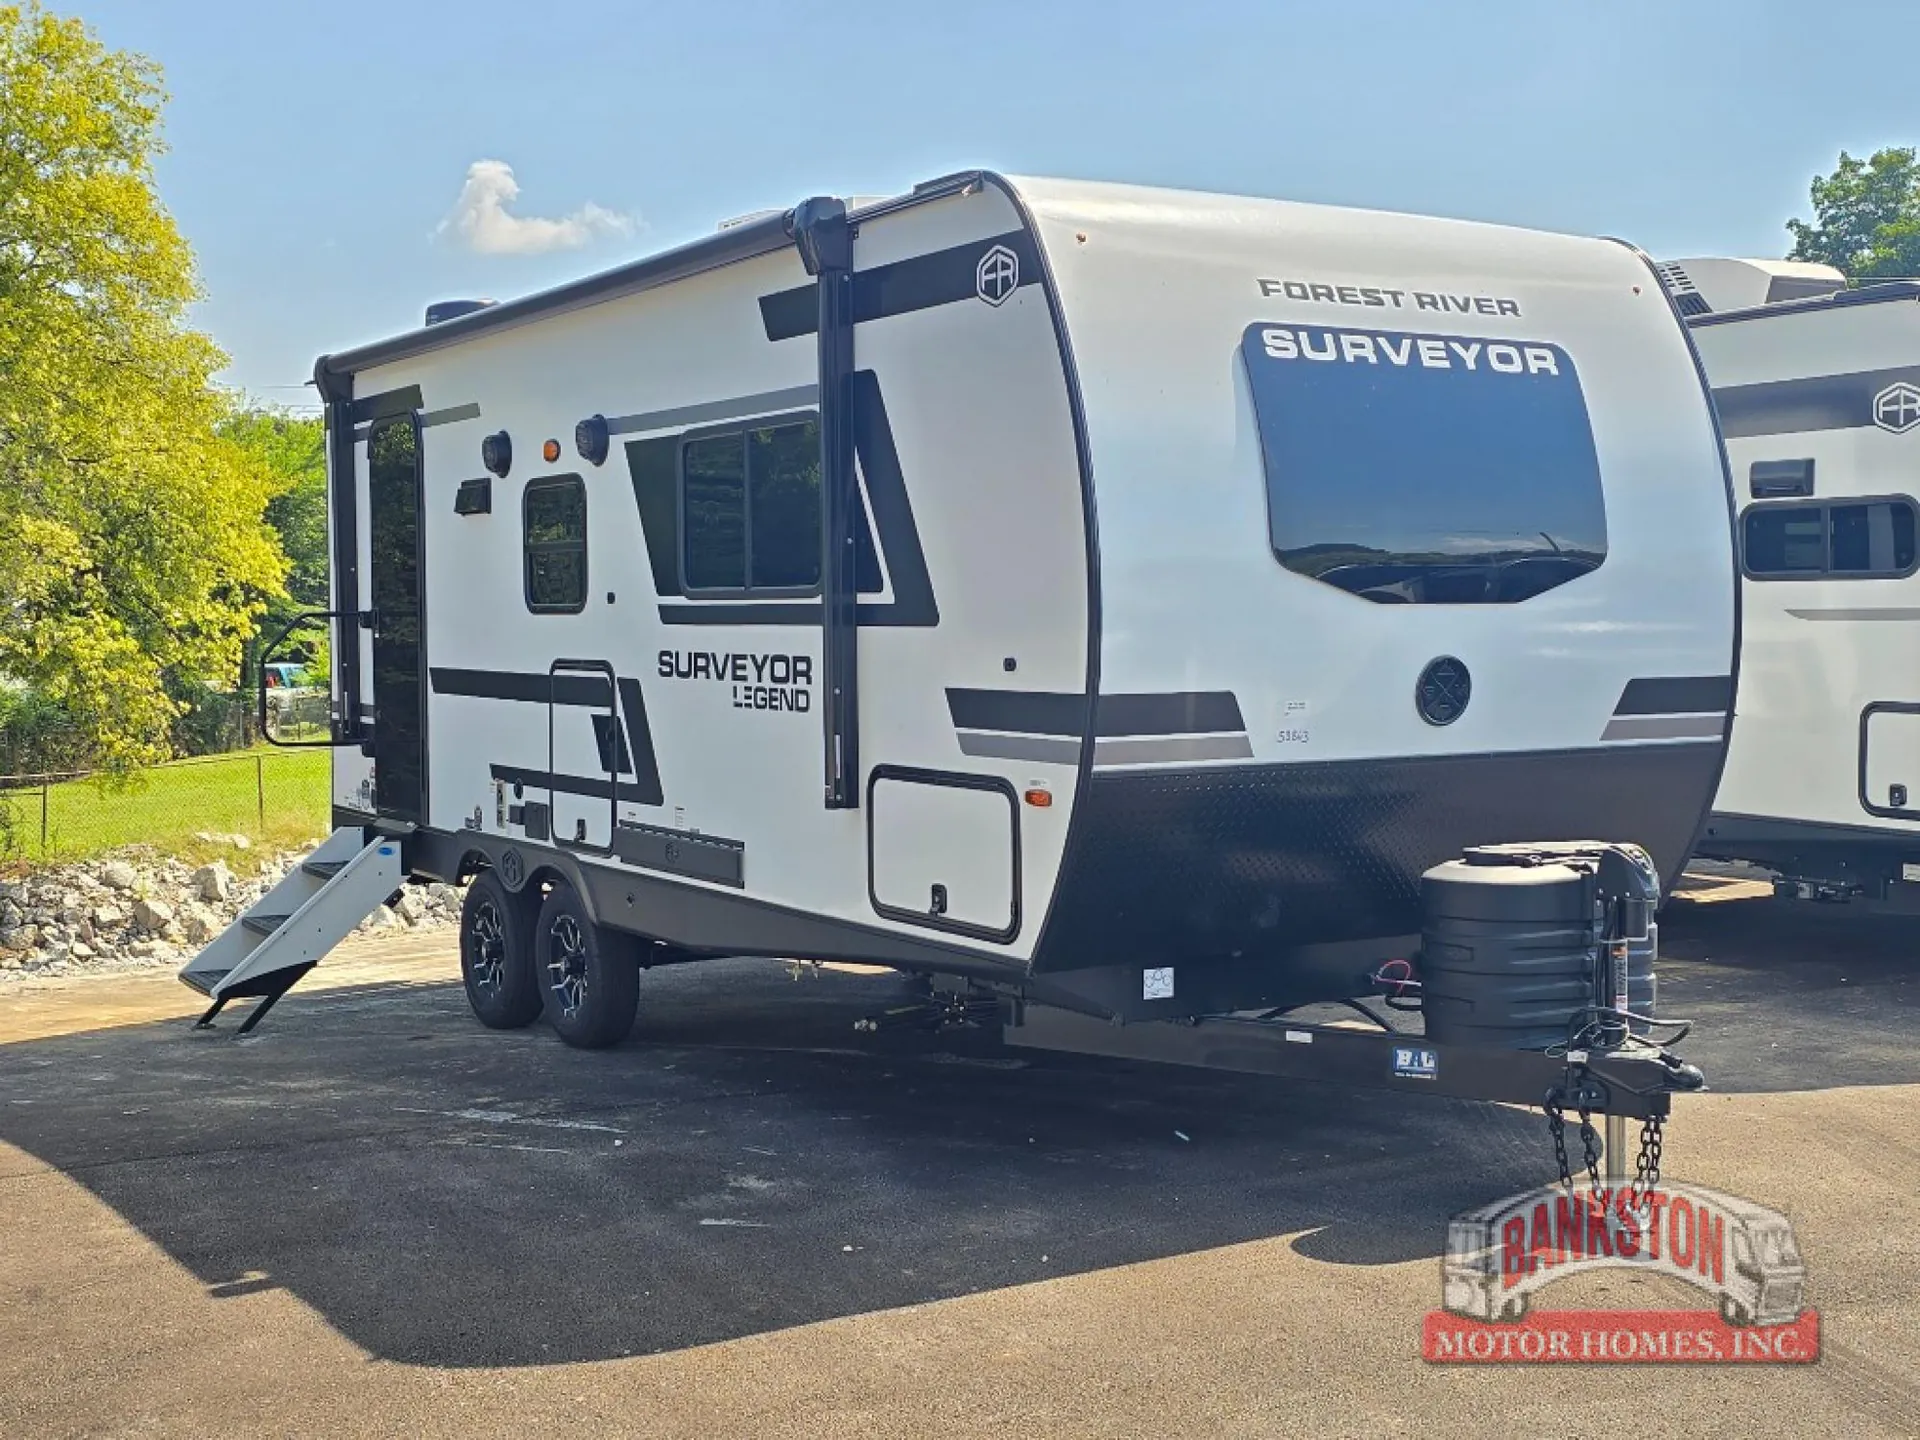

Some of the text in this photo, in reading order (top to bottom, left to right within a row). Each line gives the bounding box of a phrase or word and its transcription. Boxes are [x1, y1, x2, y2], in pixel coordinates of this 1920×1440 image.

[1257, 278, 1521, 318] FOREST RIVER
[1261, 328, 1560, 376] SURVEYOR
[658, 650, 812, 685] SURVEYOR
[732, 685, 810, 713] LEGEND
